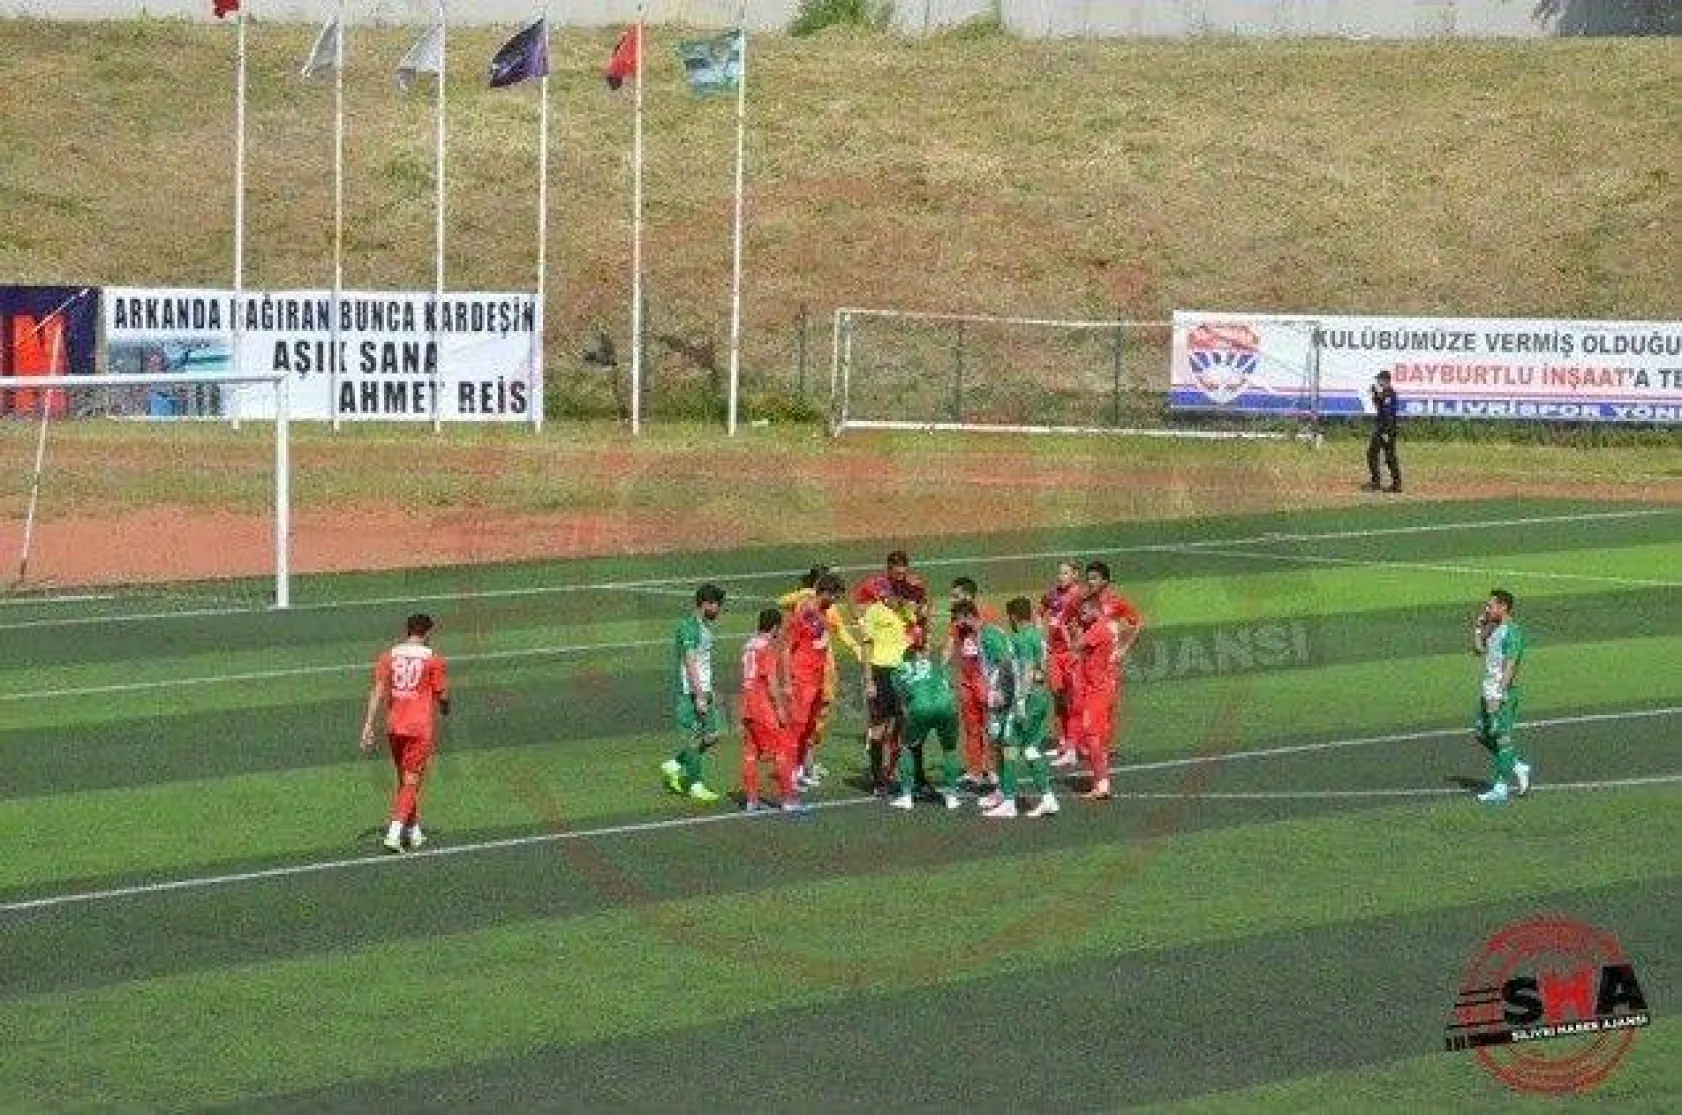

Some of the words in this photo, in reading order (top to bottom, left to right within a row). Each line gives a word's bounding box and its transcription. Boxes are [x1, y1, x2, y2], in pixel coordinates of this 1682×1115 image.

[114, 297, 221, 329] ARKANDA
[339, 299, 415, 332] BUNCA
[424, 296, 536, 340] KARDEŞİN
[359, 341, 438, 374] SANA
[1312, 325, 1476, 351] KULÜBÜMÜZE
[1485, 330, 1574, 358] VERMİŞ
[1395, 362, 1534, 385] BAYBURTLU
[339, 380, 446, 414] AHMET
[458, 375, 527, 414] REİS
